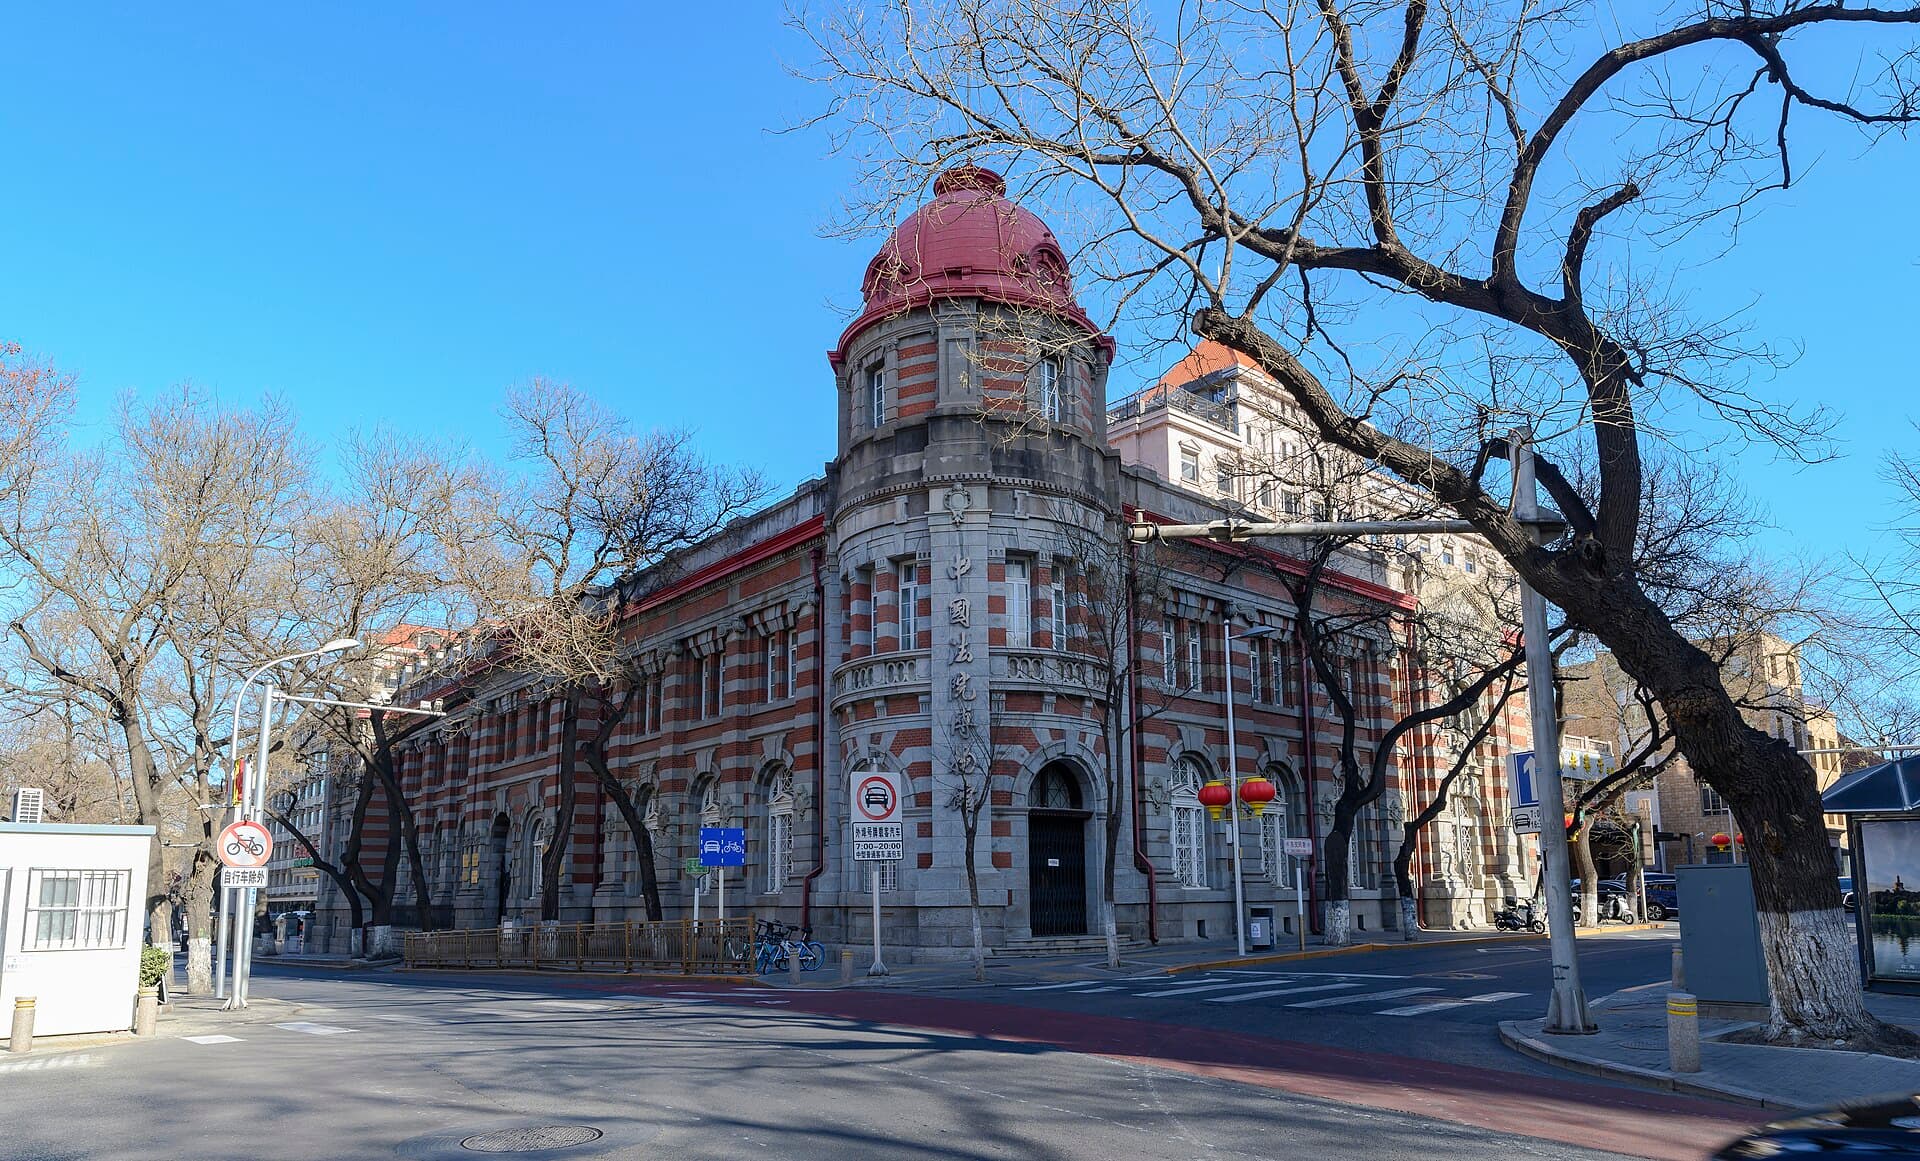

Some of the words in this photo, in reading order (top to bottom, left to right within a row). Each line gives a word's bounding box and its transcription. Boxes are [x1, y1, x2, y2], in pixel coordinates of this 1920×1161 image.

[224, 869, 265, 885] 自行车除外
